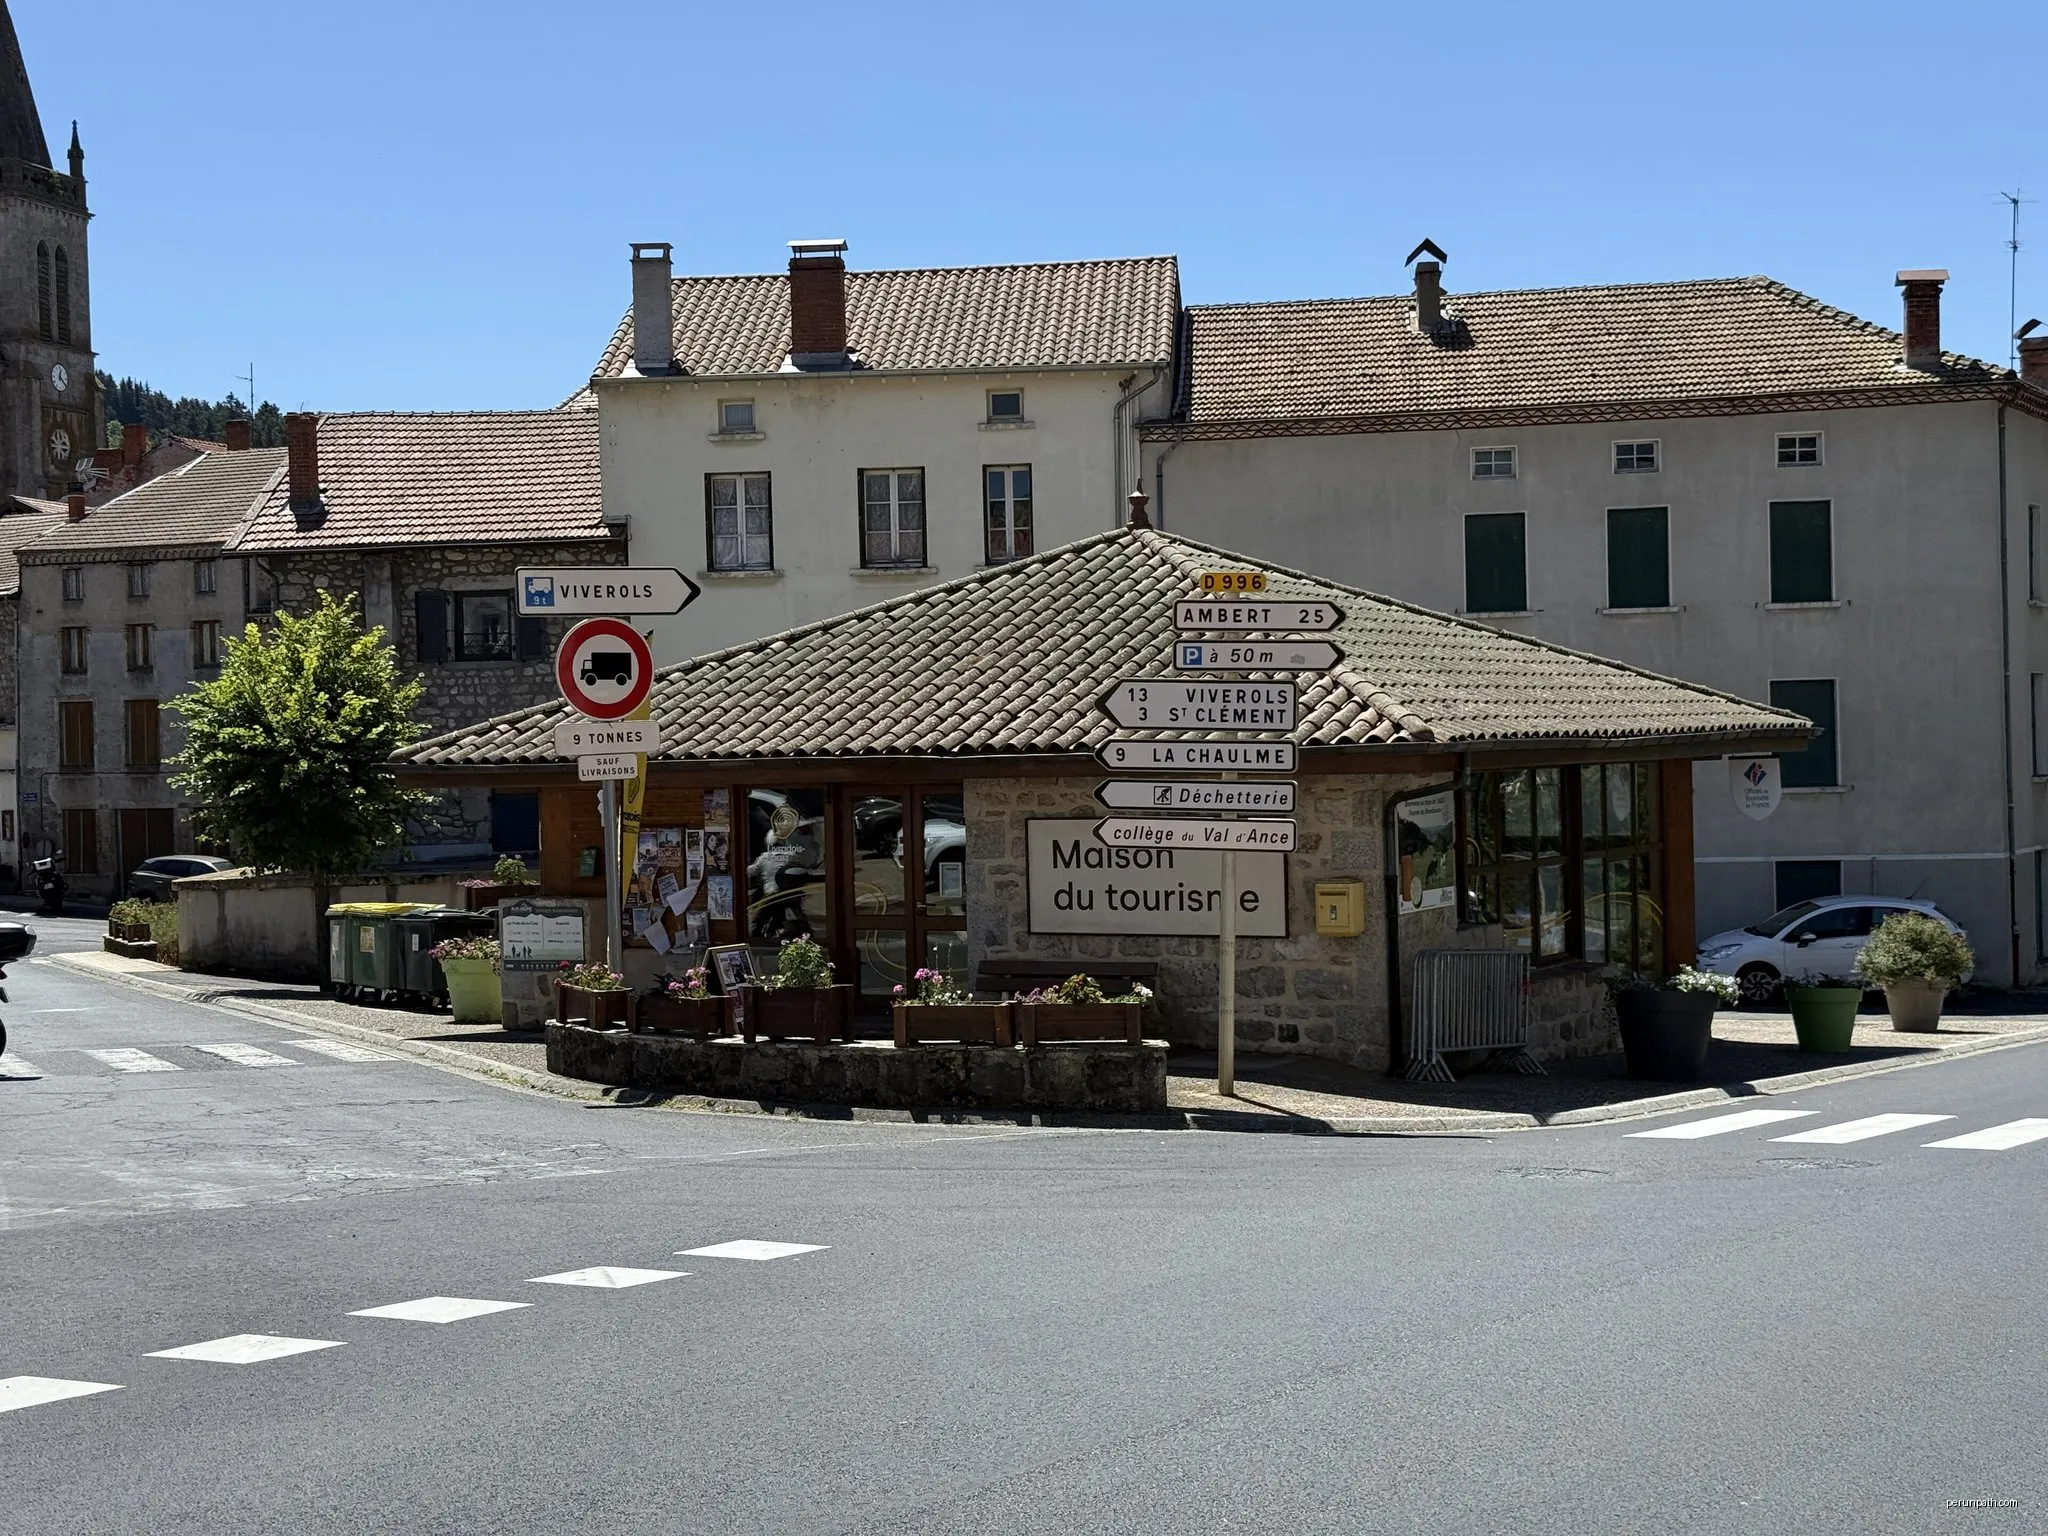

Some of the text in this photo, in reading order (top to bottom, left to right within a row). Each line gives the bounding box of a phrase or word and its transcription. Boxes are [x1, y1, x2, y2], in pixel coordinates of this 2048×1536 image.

[559, 584, 653, 599] VIVEROLS
[1183, 608, 1324, 624] AMBERT 25
[1209, 648, 1219, 663] à
[1128, 687, 1288, 705] 13 VIVEROLS
[1138, 706, 1148, 722] 3
[1195, 704, 1287, 724] CLÉMENT
[574, 731, 643, 746] 9 TONNES
[596, 757, 620, 766] SAUF
[1115, 747, 1285, 764] 9 LA CHAULME
[581, 767, 636, 778] LIVRAISONS
[1178, 788, 1289, 806] Déchetterie
[1113, 825, 1174, 844] collège
[1181, 831, 1194, 842] du
[1204, 827, 1230, 842] Val
[1052, 839, 1174, 869] Maison
[1053, 881, 1094, 911] du
